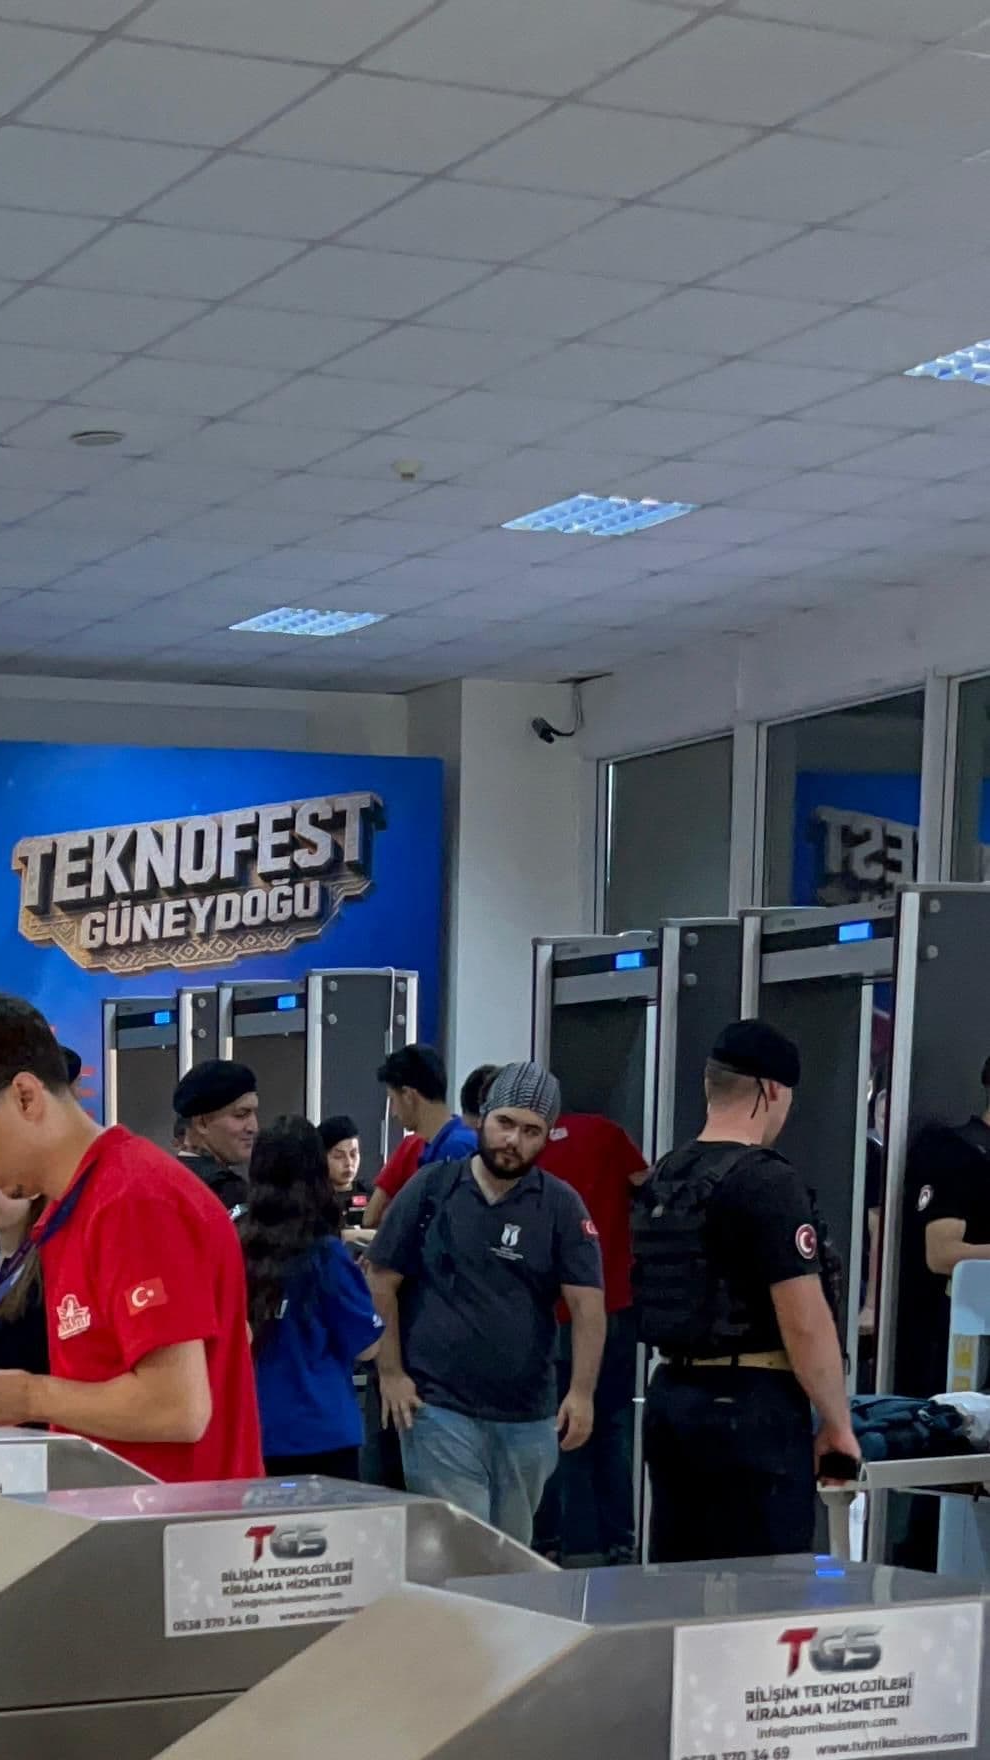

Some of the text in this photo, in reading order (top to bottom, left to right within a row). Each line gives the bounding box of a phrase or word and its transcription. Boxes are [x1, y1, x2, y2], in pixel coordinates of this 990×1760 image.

[17, 795, 373, 907] TEKNOFEST
[81, 879, 321, 950] GÜNEYDOĞU
[244, 1523, 329, 1563] TGS
[221, 1559, 354, 1583] BİLİŞİM TEKNOLOJİLERİ
[222, 1573, 352, 1596] KİRALAMA HİZMETLERİ
[173, 1618, 201, 1632] 0538
[204, 1616, 225, 1630] 370
[229, 1615, 242, 1627] 34
[777, 1624, 883, 1677] TGS
[745, 1674, 914, 1704] BİLİŞİM TEKNOLOJİLERİ
[745, 1693, 910, 1722] KİRALAMA HİZMETLERİ
[772, 1745, 791, 1760] 69
